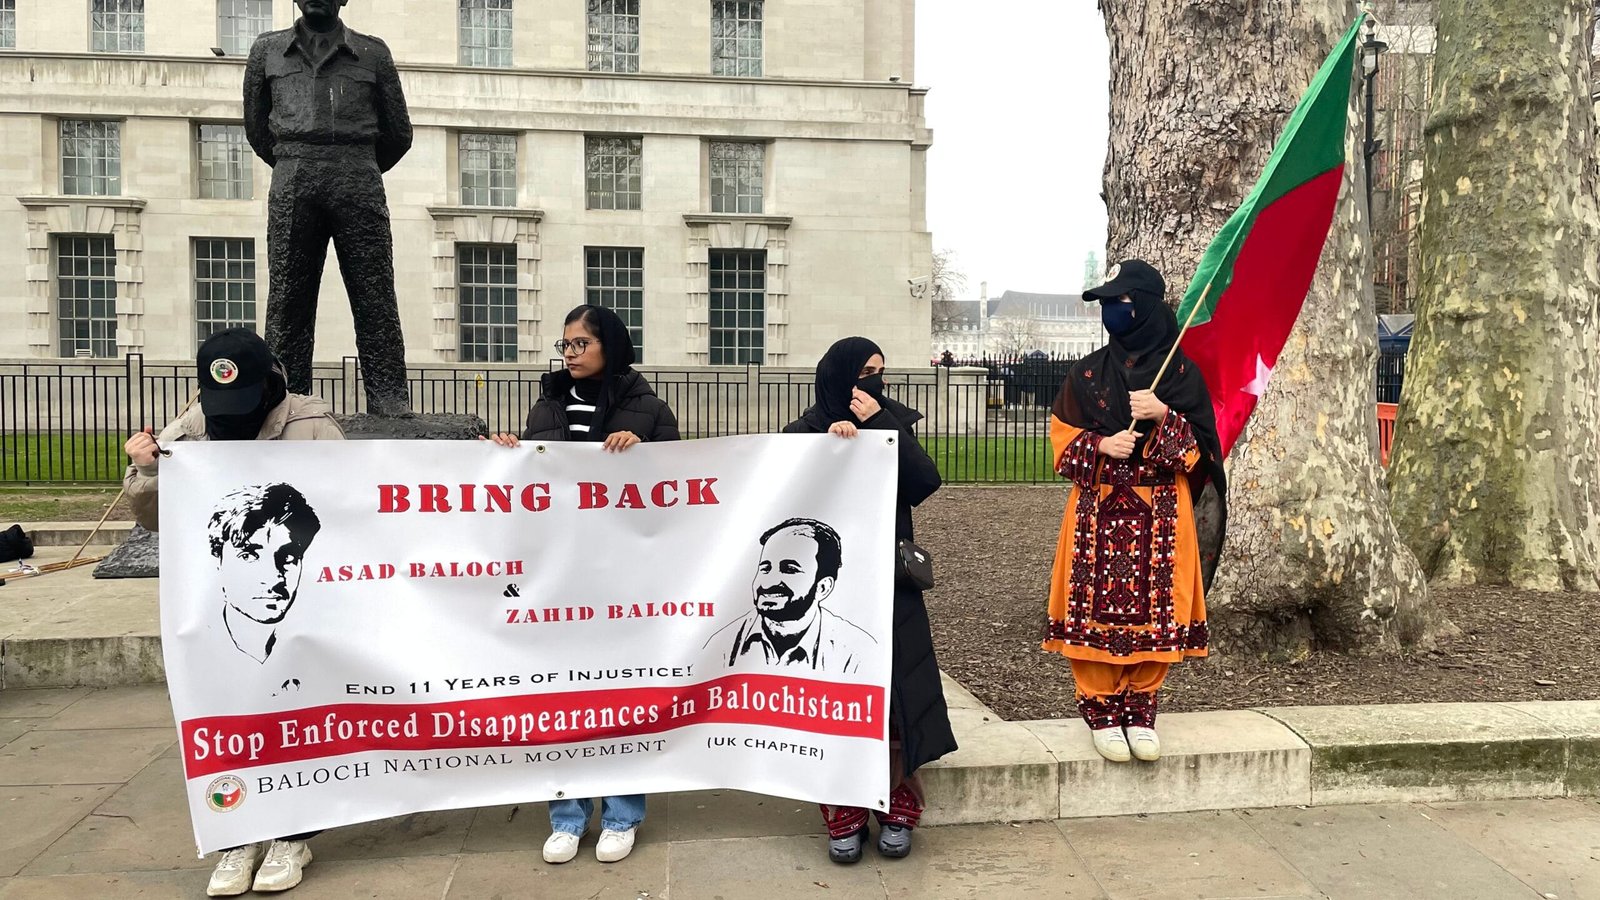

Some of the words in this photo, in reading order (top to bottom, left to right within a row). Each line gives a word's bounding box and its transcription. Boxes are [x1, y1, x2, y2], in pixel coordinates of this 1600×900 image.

[377, 483, 551, 513] BRING
[577, 477, 720, 510] BACK
[316, 563, 396, 583] ASAD
[408, 560, 524, 578] BALOCH
[503, 583, 520, 598] &
[506, 606, 595, 624] ZAHID
[607, 602, 715, 619] BALOCH
[409, 681, 431, 694] 11
[193, 727, 265, 761] Stop
[279, 712, 419, 750] Enforced
[431, 703, 659, 743] Disappearances
[670, 695, 696, 719] in
[707, 682, 873, 723] Balochistan!
[707, 737, 737, 749] (UK
[744, 738, 825, 760] CHAPTER)
[257, 761, 370, 794] BALOCH
[383, 753, 513, 774] NATIONAL
[525, 739, 667, 763] MOVEMENT
